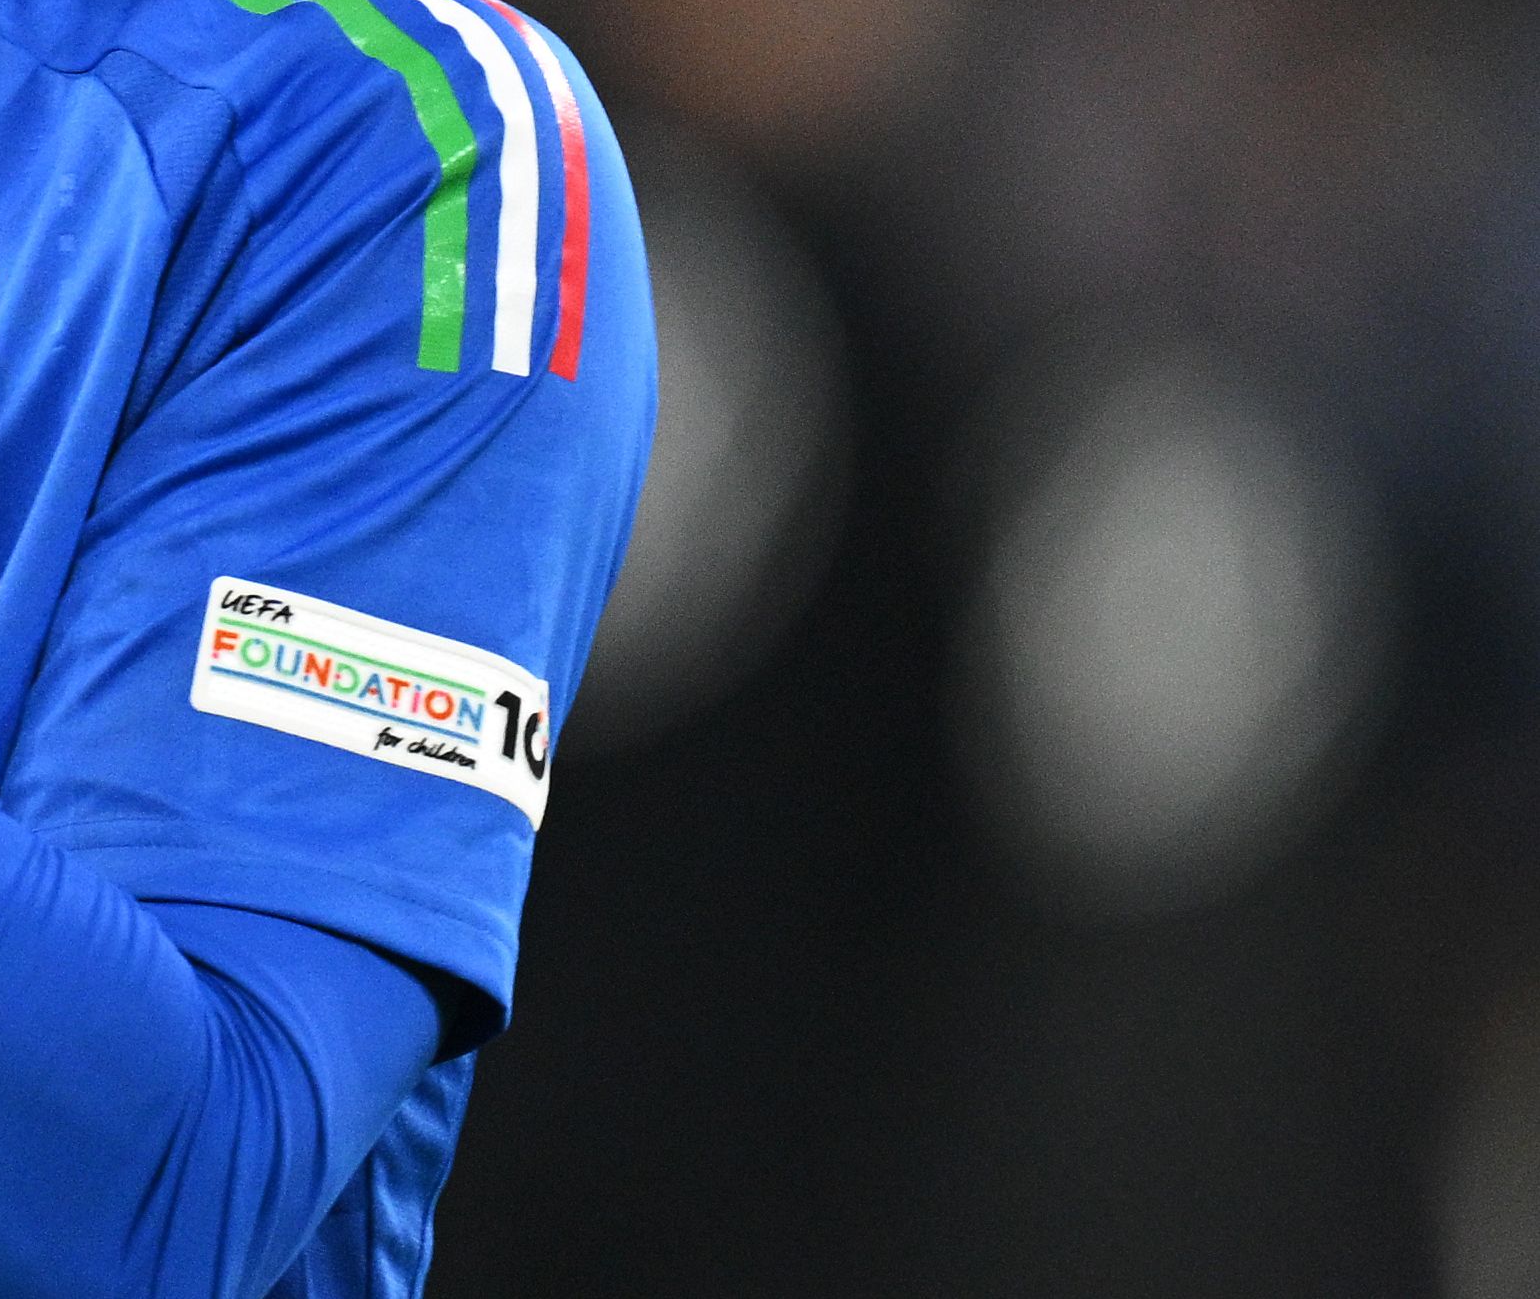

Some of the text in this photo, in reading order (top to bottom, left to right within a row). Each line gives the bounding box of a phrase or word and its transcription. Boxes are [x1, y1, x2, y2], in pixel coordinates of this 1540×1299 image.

[221, 590, 295, 624] UEFA
[373, 726, 477, 770] for children
